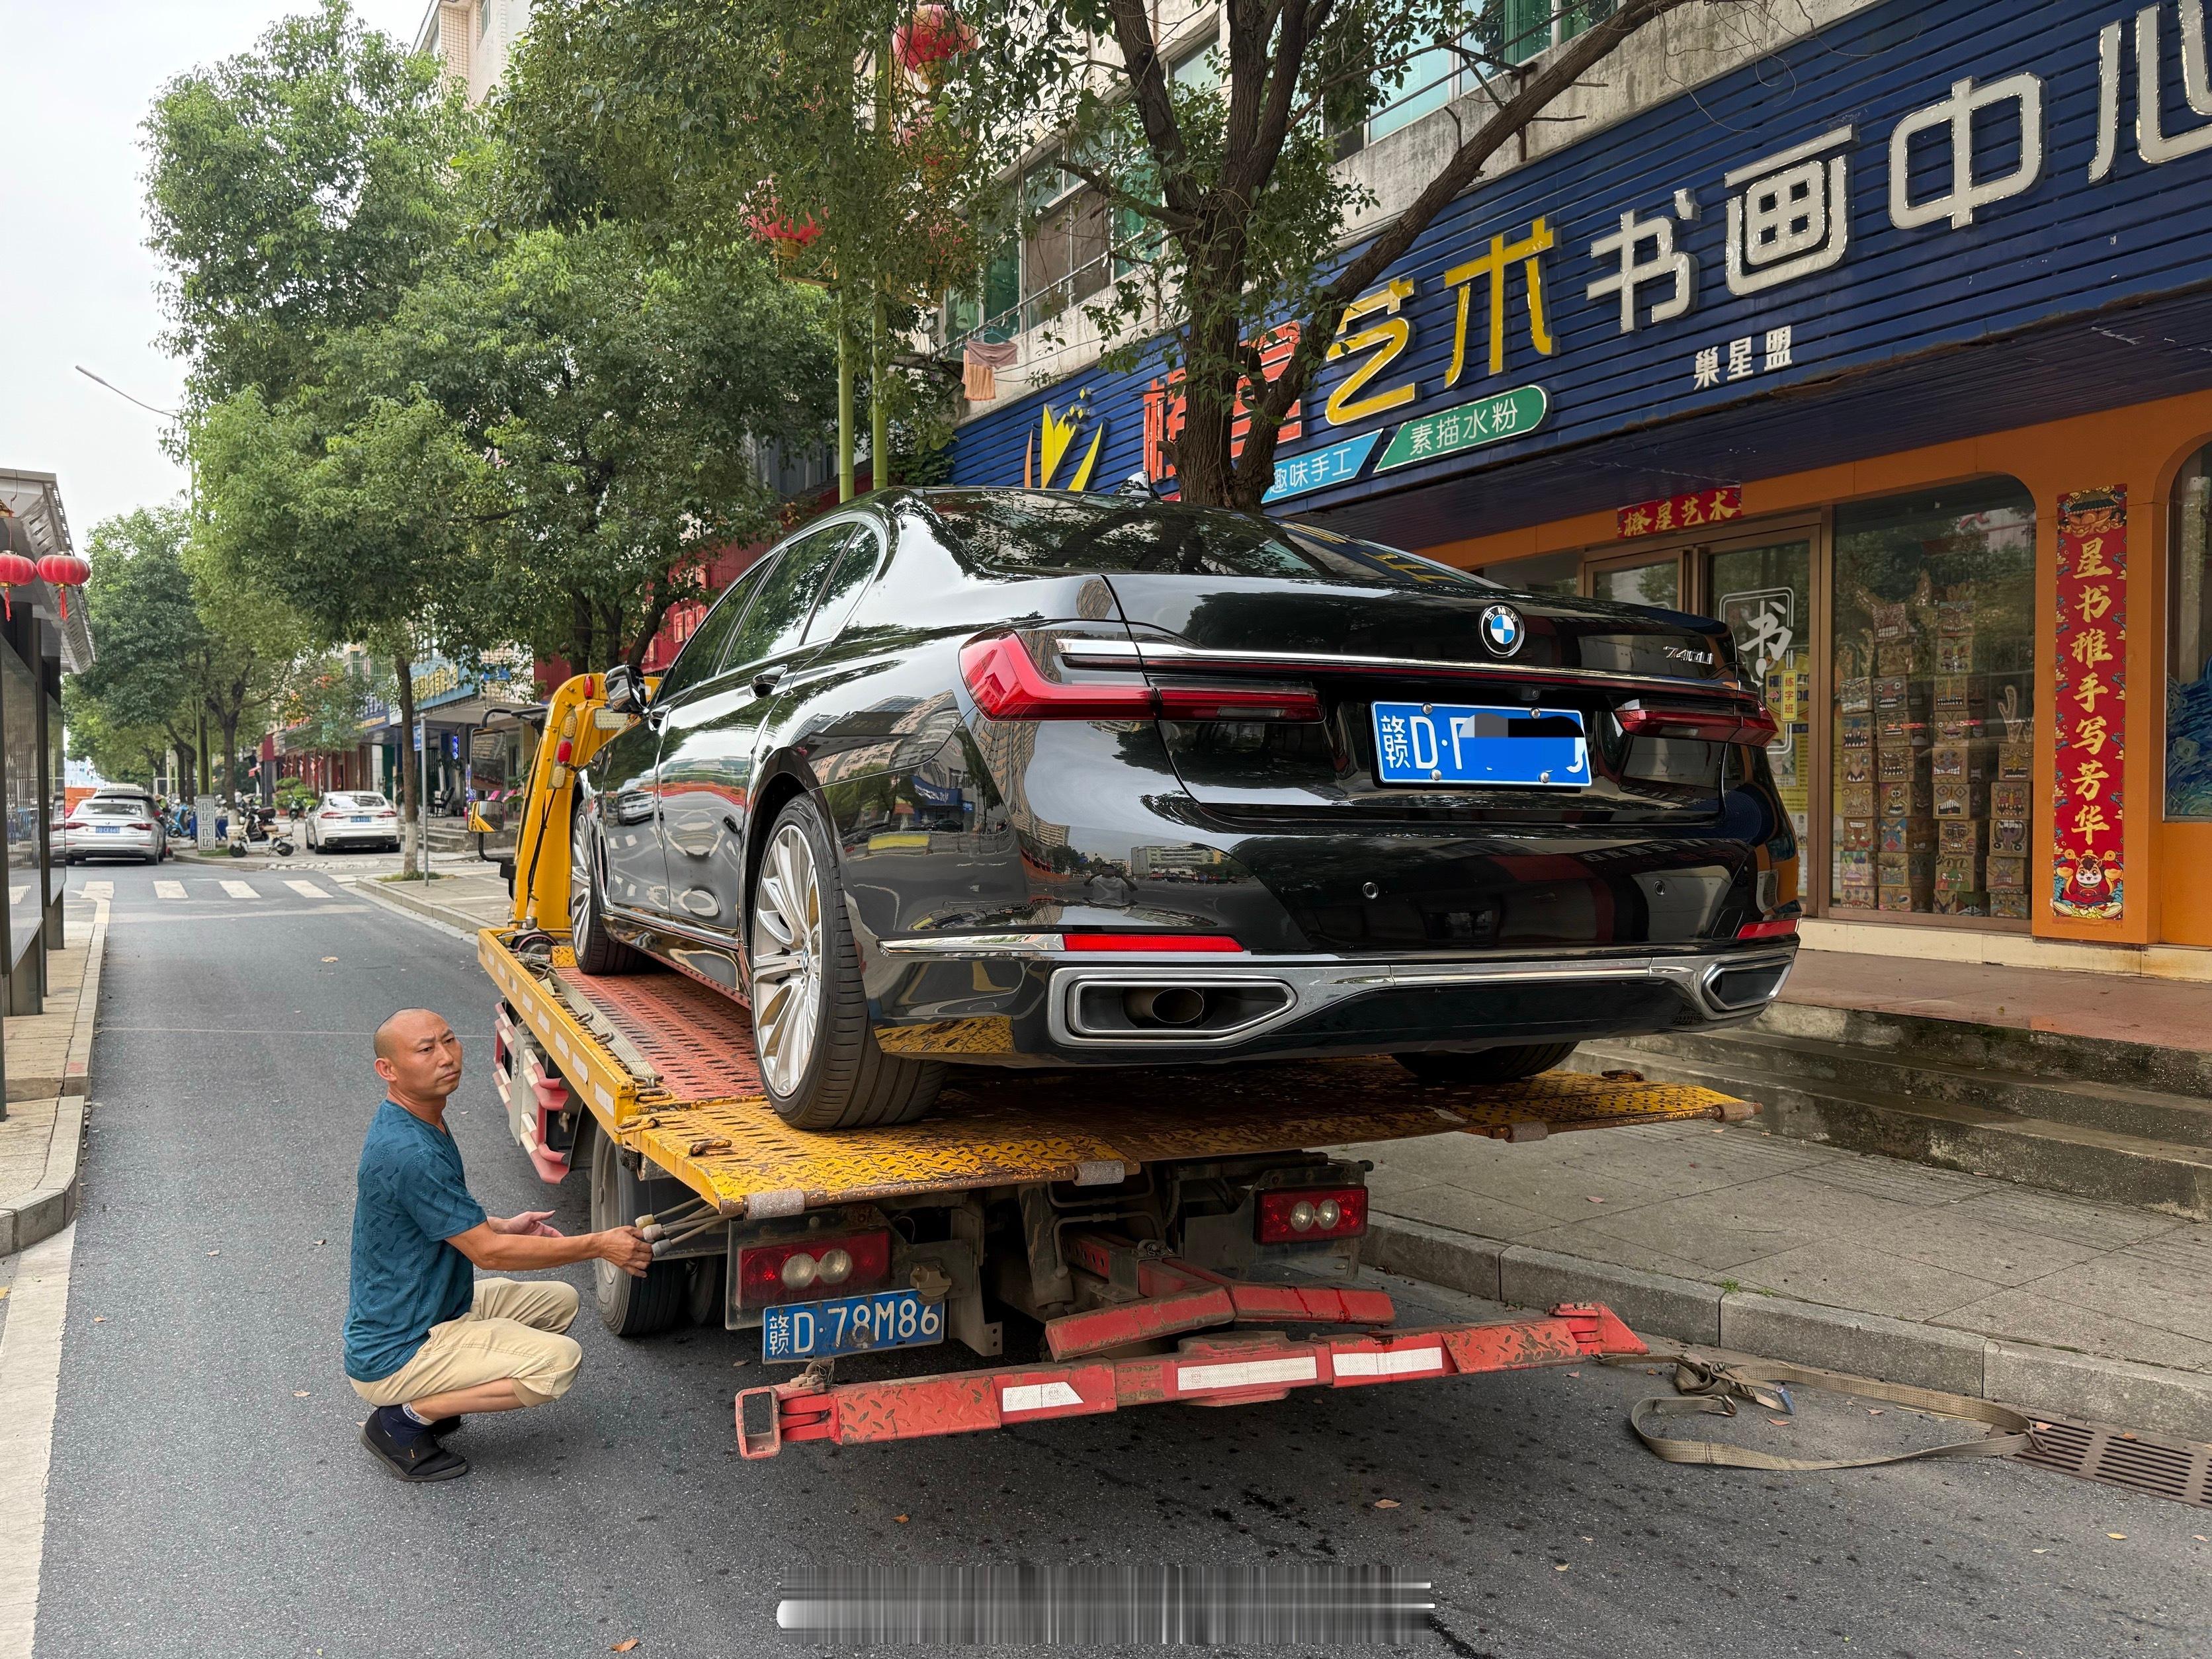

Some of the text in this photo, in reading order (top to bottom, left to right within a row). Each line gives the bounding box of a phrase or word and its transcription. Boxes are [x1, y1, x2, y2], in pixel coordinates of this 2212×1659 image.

[1693, 325, 1793, 391] 巢星盟
[1409, 398, 1518, 456] 素描水粉
[1624, 489, 1740, 536] 橙星艺术
[1486, 607, 1518, 623] BMW
[1784, 677, 1795, 714] 练字班
